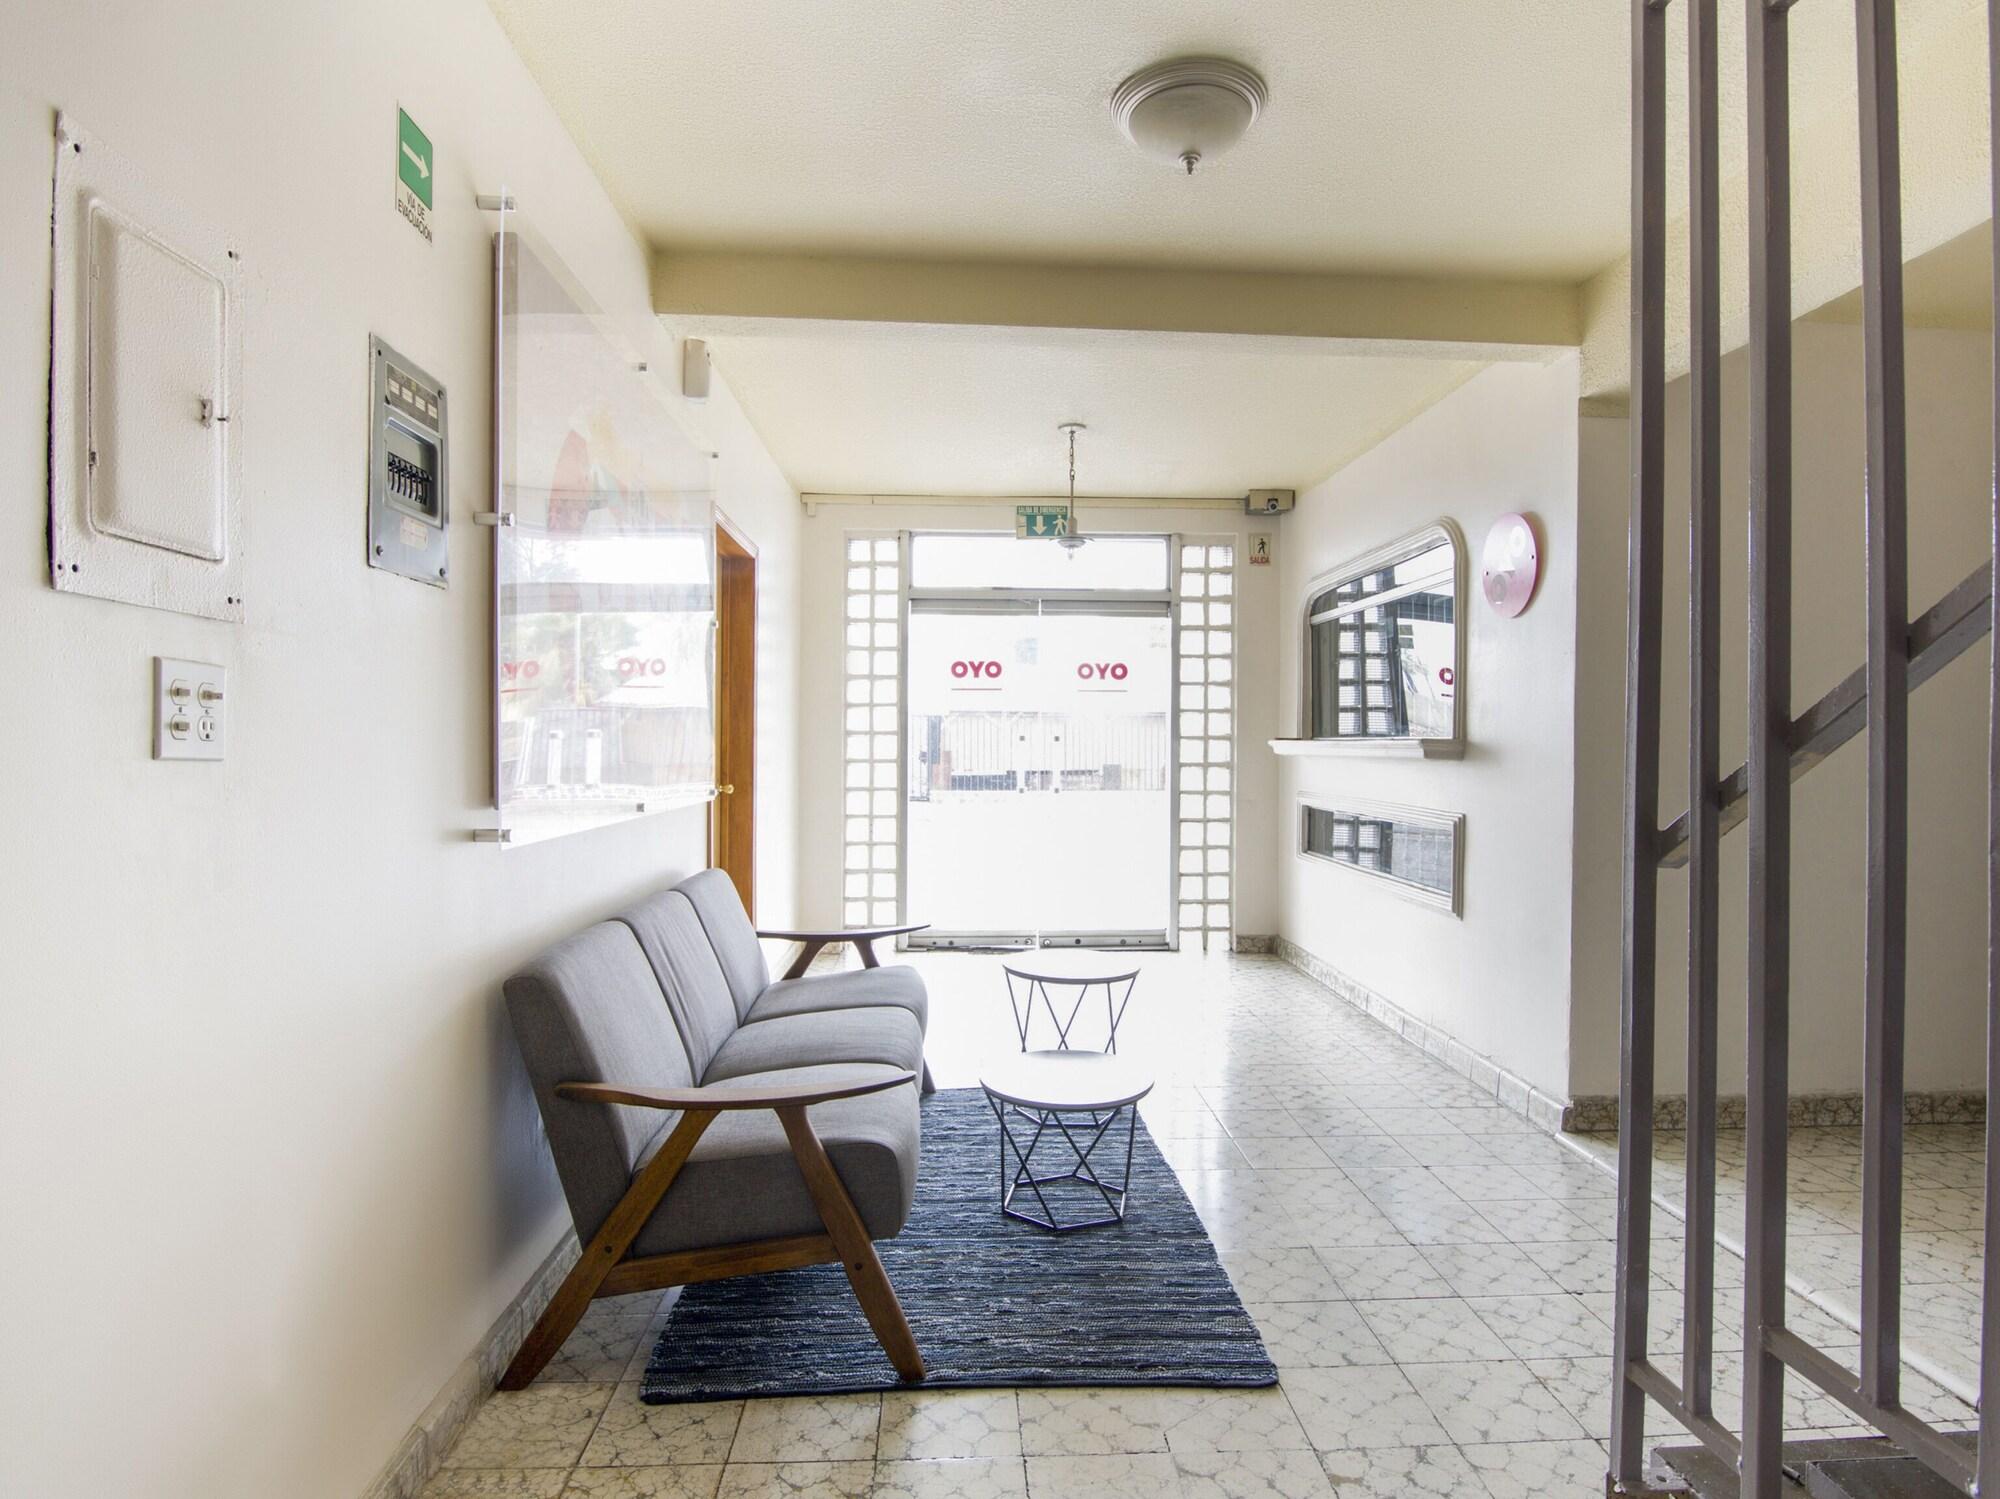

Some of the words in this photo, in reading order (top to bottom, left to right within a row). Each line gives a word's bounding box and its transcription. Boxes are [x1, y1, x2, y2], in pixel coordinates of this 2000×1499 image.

[417, 202, 425, 221] DE
[1249, 555, 1270, 565] SALIDA
[951, 661, 1003, 679] OYO
[1077, 663, 1129, 680] OYO
